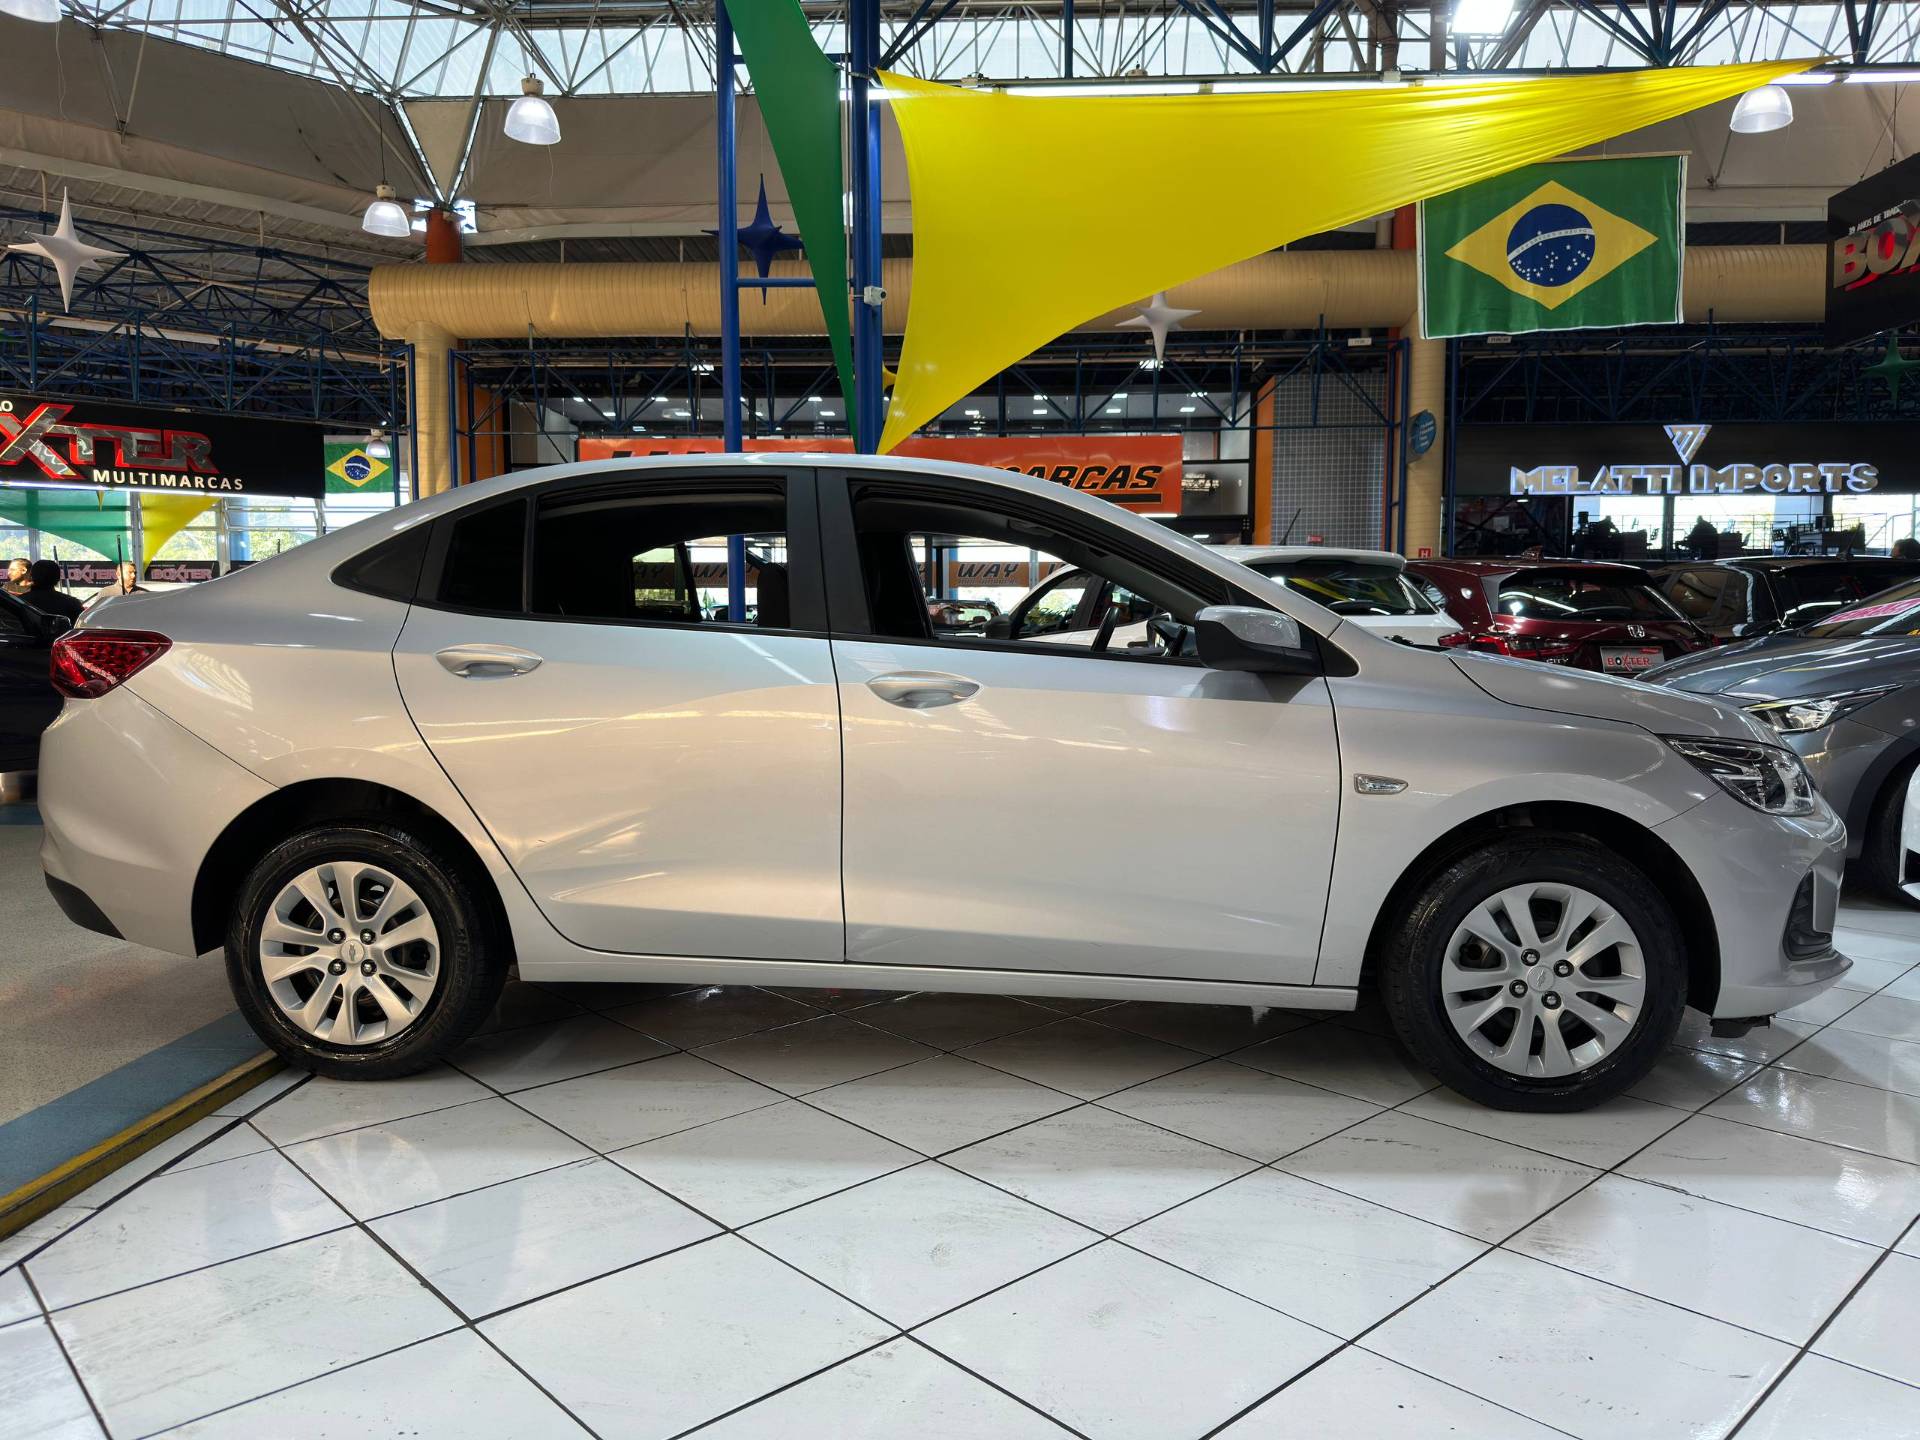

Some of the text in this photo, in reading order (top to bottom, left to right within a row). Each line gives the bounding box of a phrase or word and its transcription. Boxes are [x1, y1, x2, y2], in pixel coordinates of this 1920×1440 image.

[92, 468, 244, 491] MULTIMARCAS
[1510, 463, 1880, 496] MELATTI IMPORTS
[957, 564, 1019, 578] WAY
[1607, 652, 1650, 672] BOXTER
